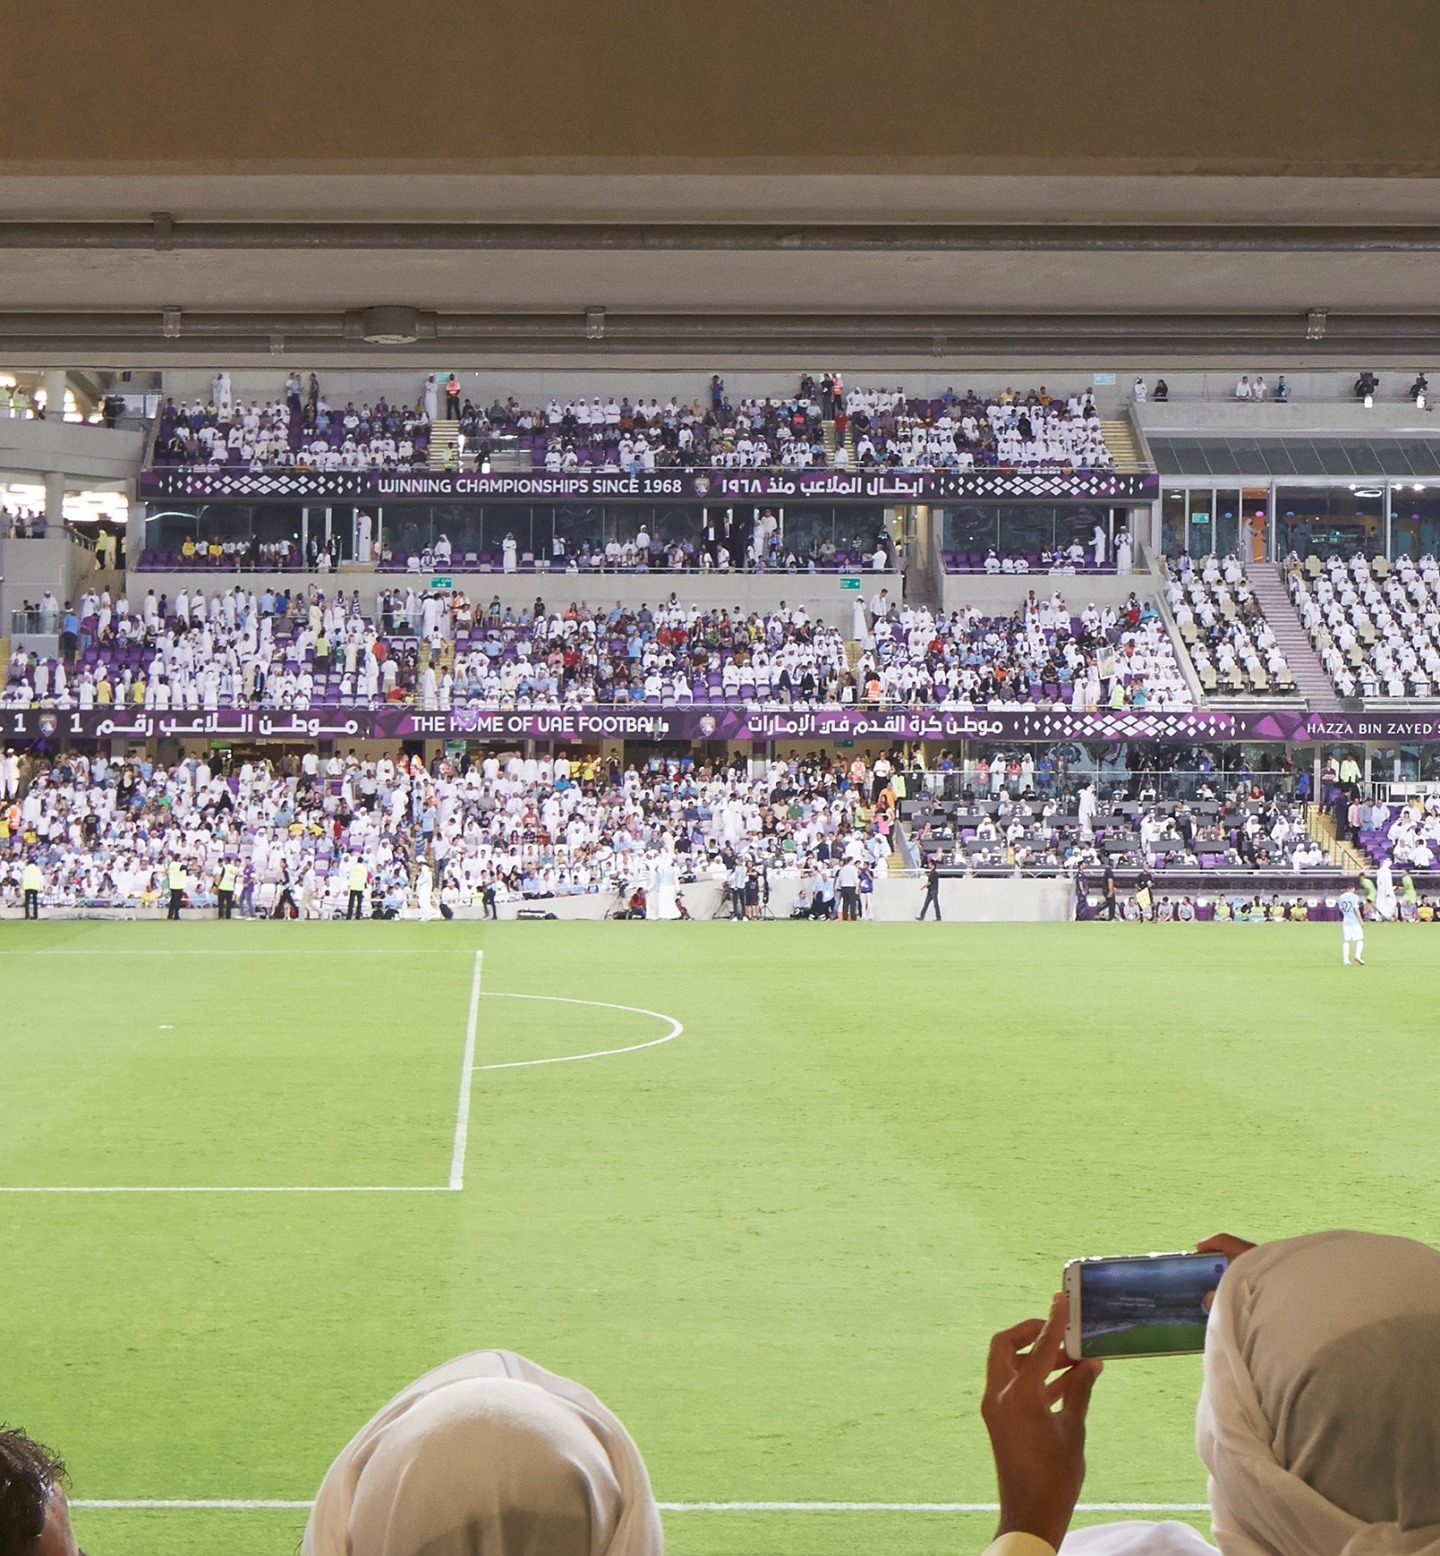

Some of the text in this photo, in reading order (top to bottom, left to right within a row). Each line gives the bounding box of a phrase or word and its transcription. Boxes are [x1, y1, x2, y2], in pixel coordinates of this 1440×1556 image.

[378, 478, 682, 494] WINNING CHAMPIONSHIPS SINCE 1968
[722, 479, 763, 494] ١٩٦٨
[766, 476, 796, 495] منذ
[14, 713, 27, 732] 1
[95, 713, 154, 737] رقم
[159, 712, 254, 737] اللاعب
[258, 713, 359, 737] موطن
[410, 715, 446, 732] THE
[507, 715, 534, 733] OF
[537, 716, 575, 733] UAE
[578, 716, 670, 735] FOOTBALL
[747, 713, 1004, 737] موطن كرة القدم في الإمارات
[1306, 722, 1354, 737] HAZZA
[1358, 723, 1382, 735] BIN
[1386, 723, 1433, 735] ZAYED
